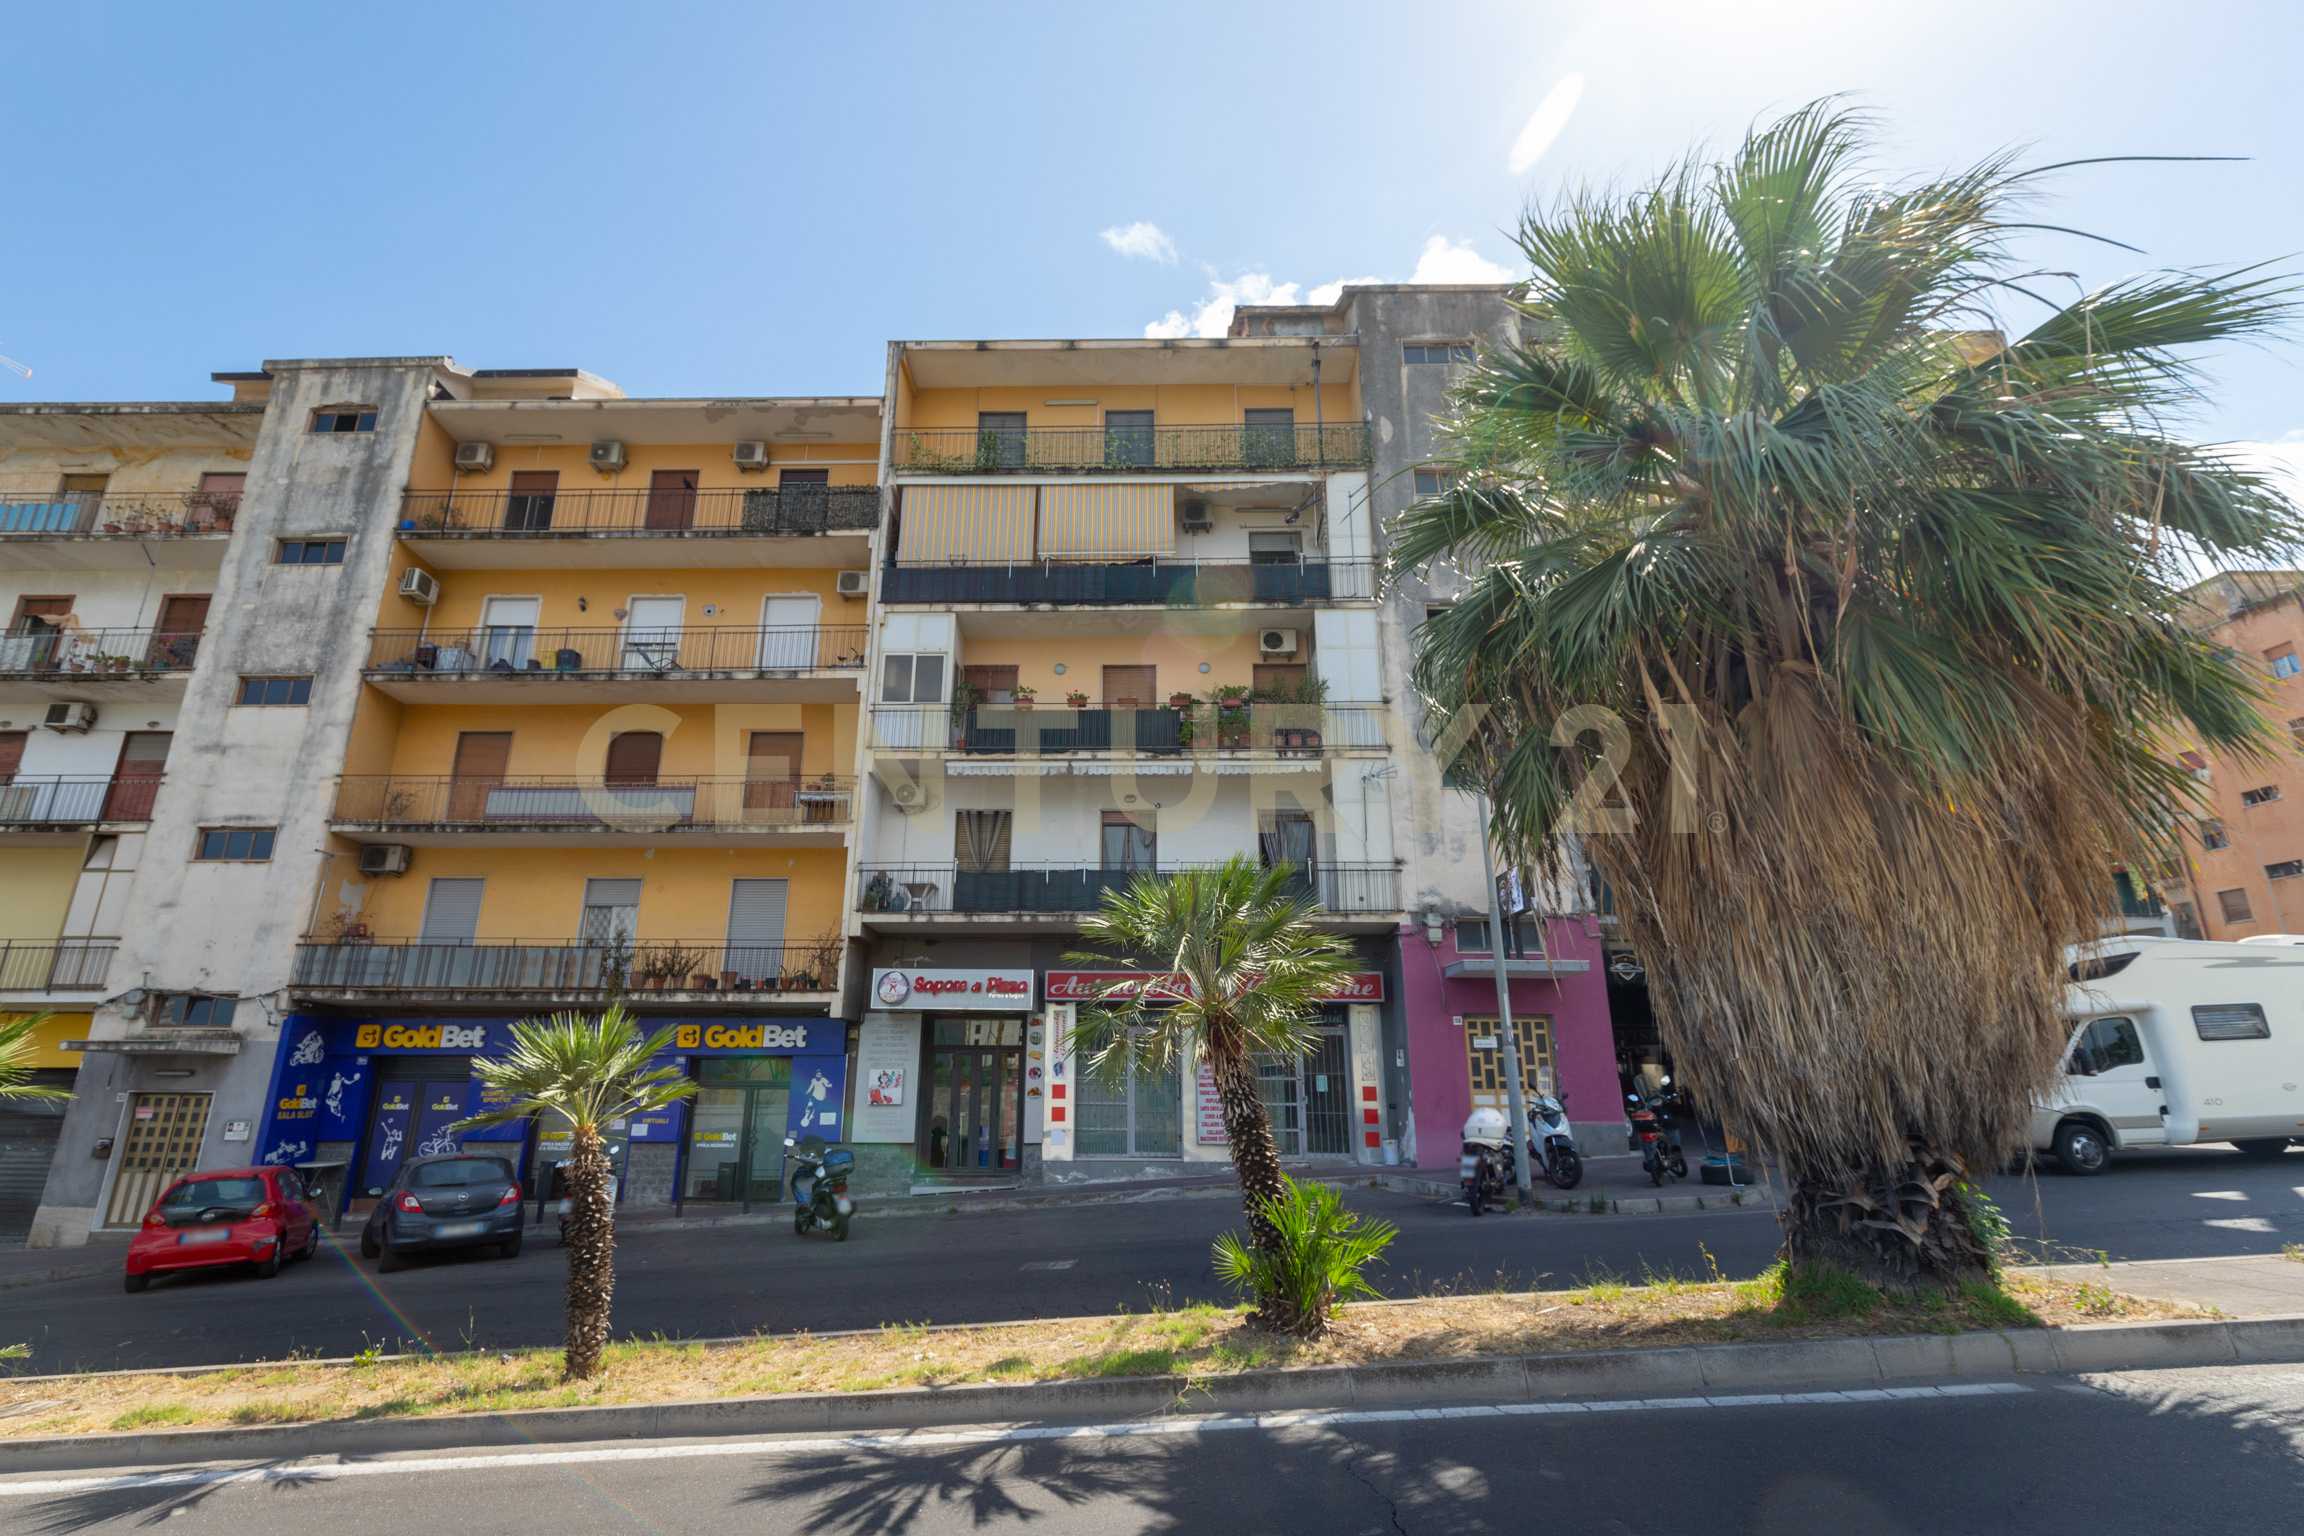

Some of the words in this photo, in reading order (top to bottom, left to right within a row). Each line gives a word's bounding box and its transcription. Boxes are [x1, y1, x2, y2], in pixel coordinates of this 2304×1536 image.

[913, 976, 967, 997] Sapore
[986, 976, 1029, 993] Pizza
[384, 1025, 486, 1048] GoldBet
[705, 1025, 807, 1048] GoldBet
[279, 1097, 317, 1110] GoldBet
